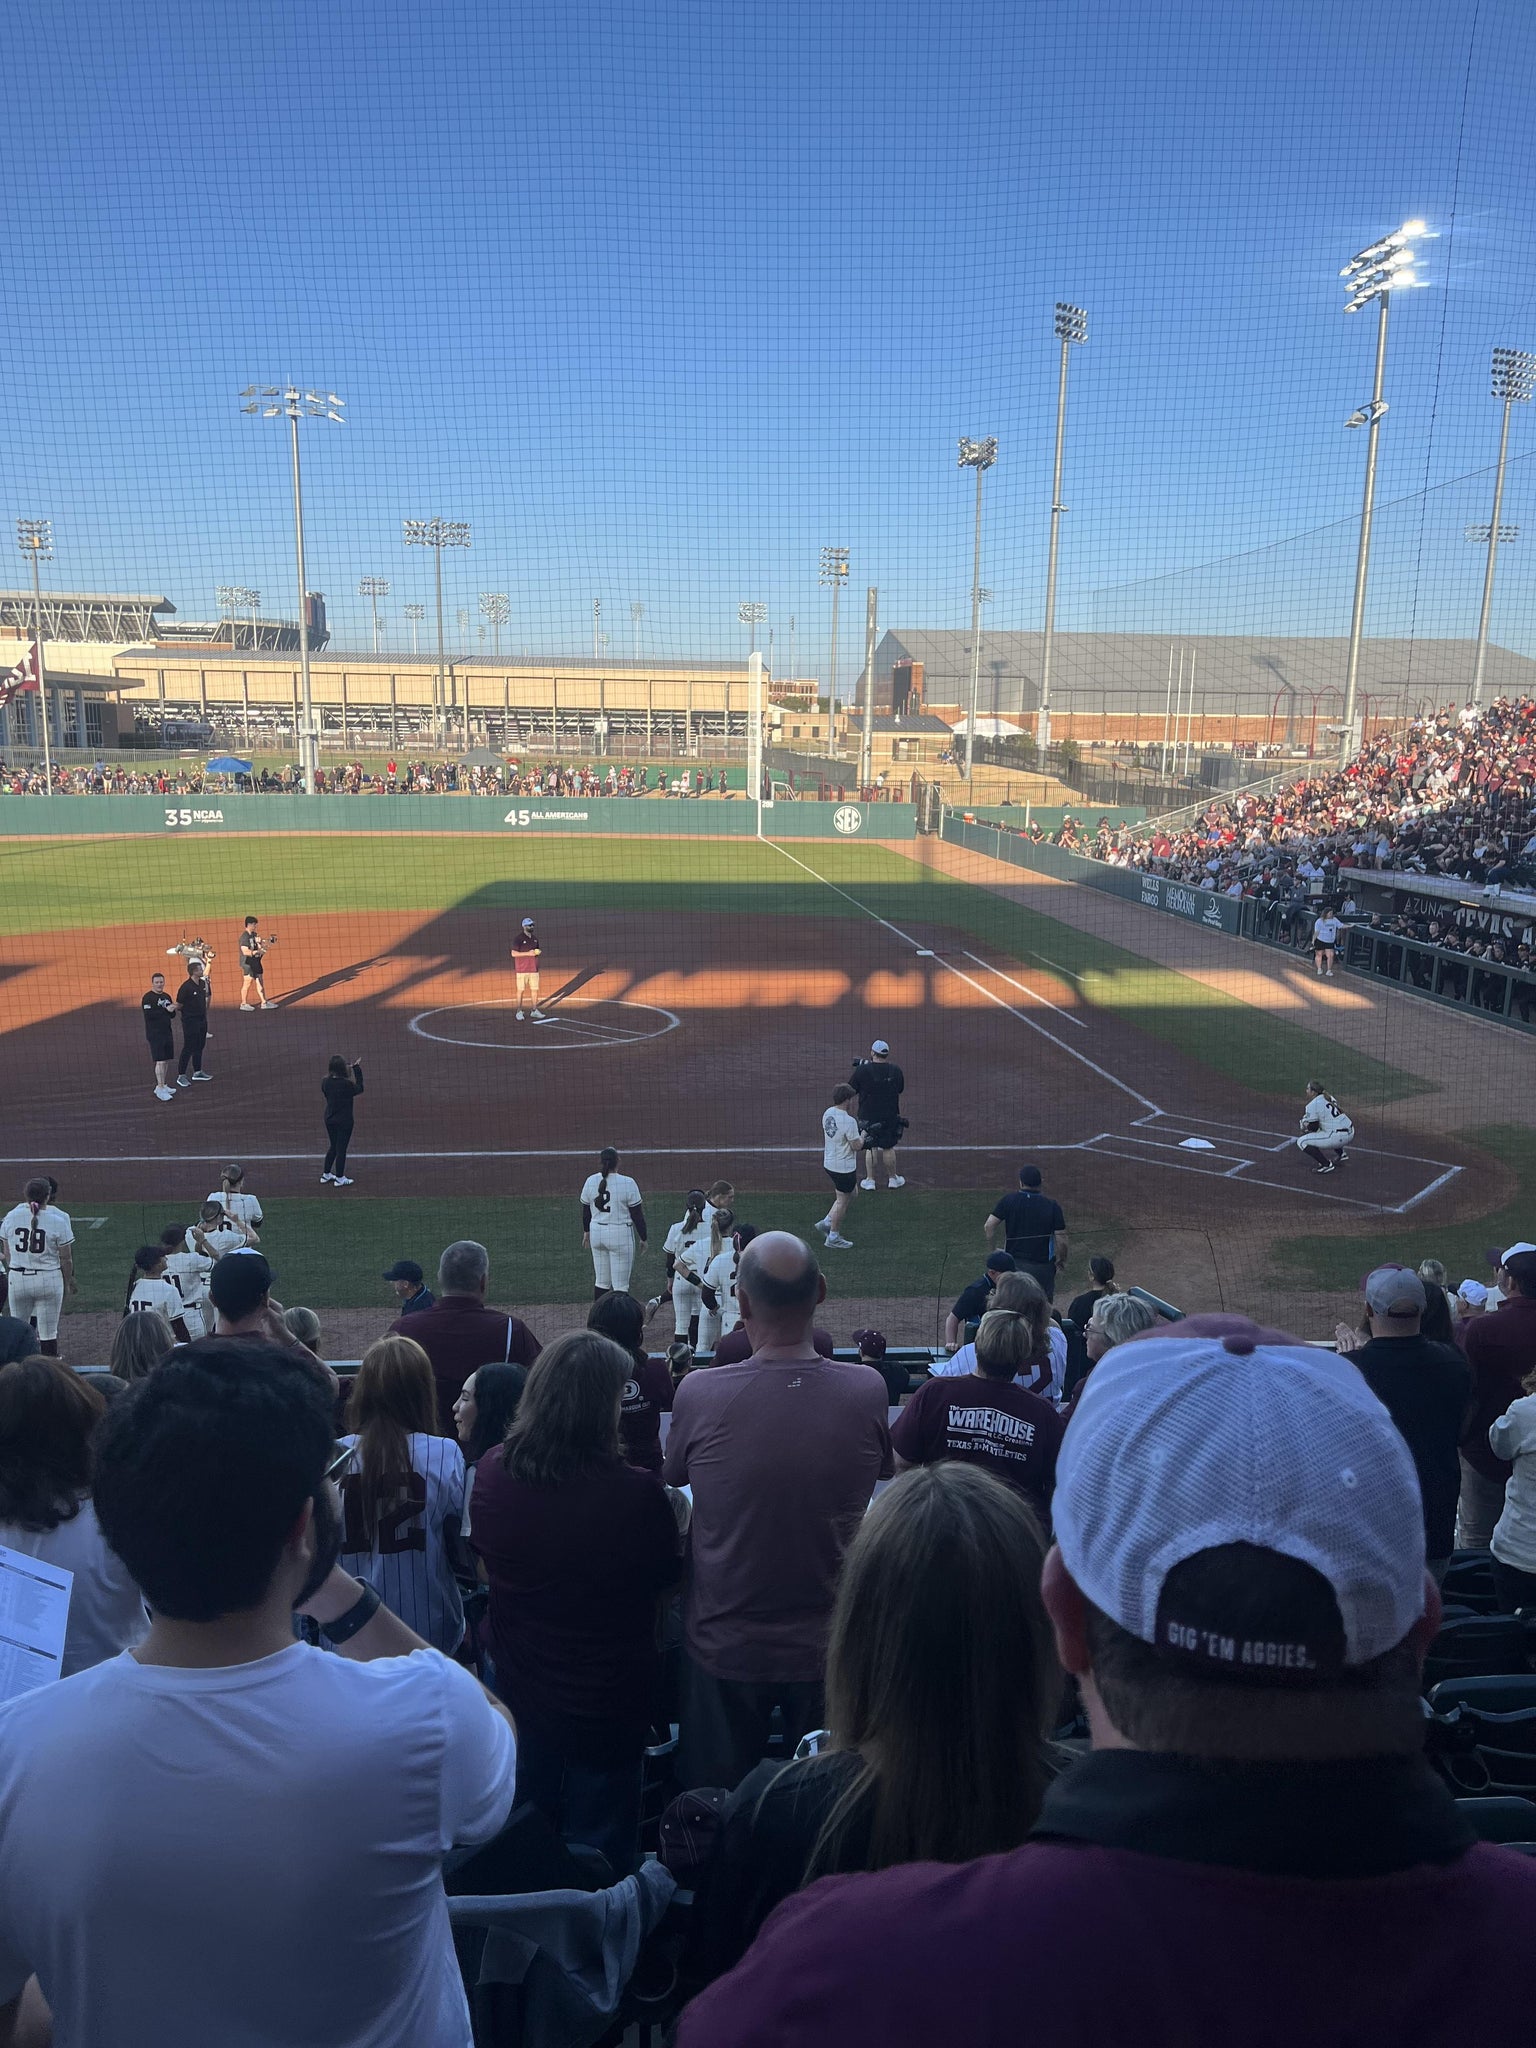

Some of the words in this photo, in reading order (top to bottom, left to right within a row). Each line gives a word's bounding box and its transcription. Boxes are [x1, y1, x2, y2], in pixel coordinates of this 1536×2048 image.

[165, 809, 193, 826] 35
[193, 810, 223, 819] NCAA
[504, 809, 530, 826] 45
[531, 811, 544, 819] ALL
[545, 812, 588, 820] AMERICANS
[835, 807, 860, 832] SEC
[1142, 876, 1159, 892] WELLS
[1141, 891, 1159, 906] FARGO
[1166, 886, 1196, 904] MEMORIAL
[1165, 895, 1195, 916] HERMANN
[1404, 897, 1444, 919] AZUNA
[1453, 907, 1513, 938] TEXAS
[948, 1409, 1035, 1441] WAREHOUSE
[947, 1440, 972, 1450] TEXAS
[1004, 1436, 1033, 1447] Creations
[1168, 1622, 1197, 1650] GIG
[1203, 1631, 1235, 1662] 'EM
